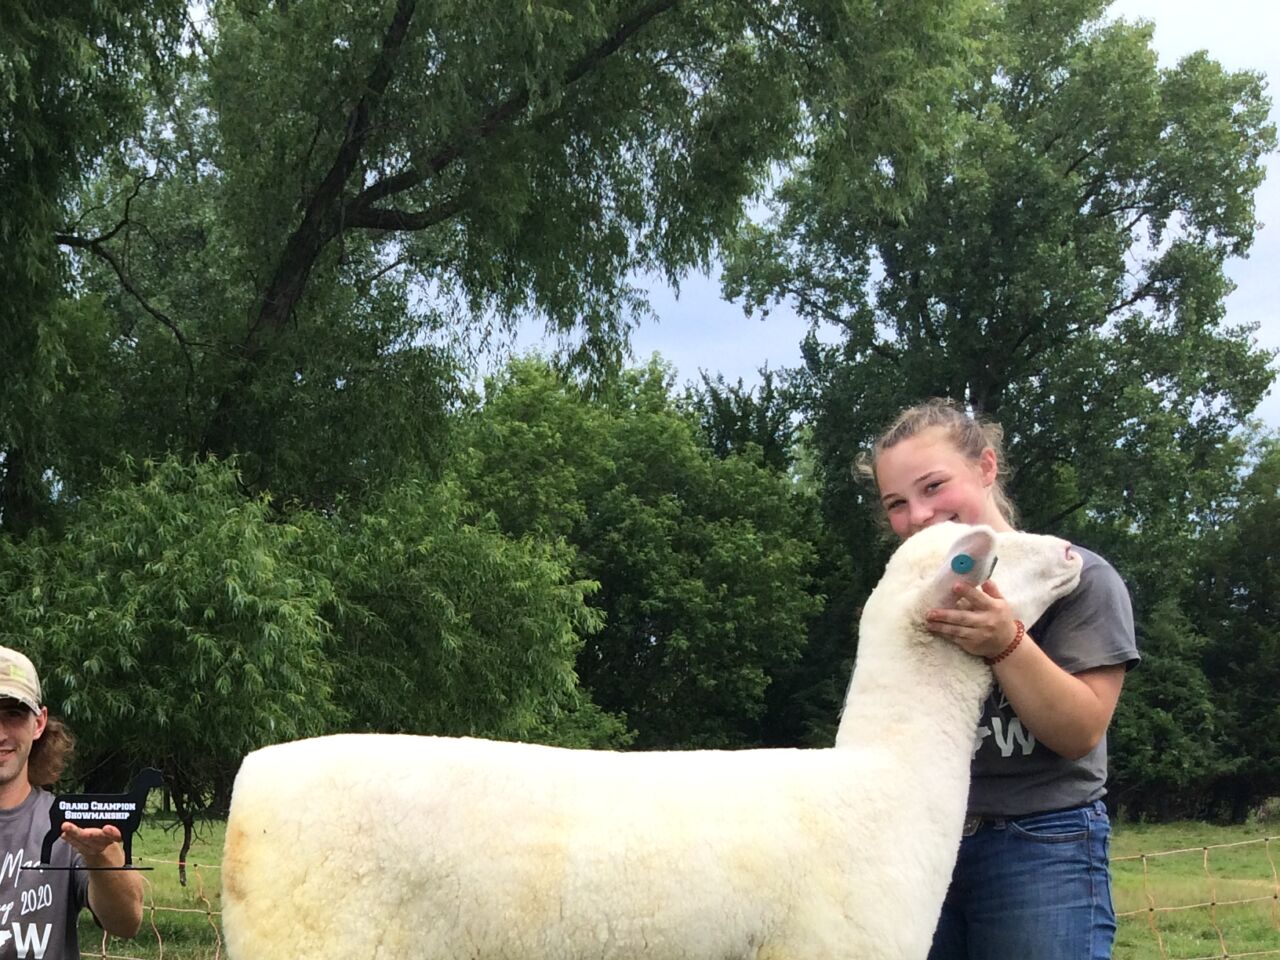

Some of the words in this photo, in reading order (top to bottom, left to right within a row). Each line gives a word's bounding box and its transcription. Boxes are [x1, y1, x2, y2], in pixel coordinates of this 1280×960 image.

[59, 801, 90, 811] GRAND
[90, 801, 136, 811] CHAMPION
[64, 810, 130, 820] SHOWMANSHIP
[20, 883, 53, 916] 2020
